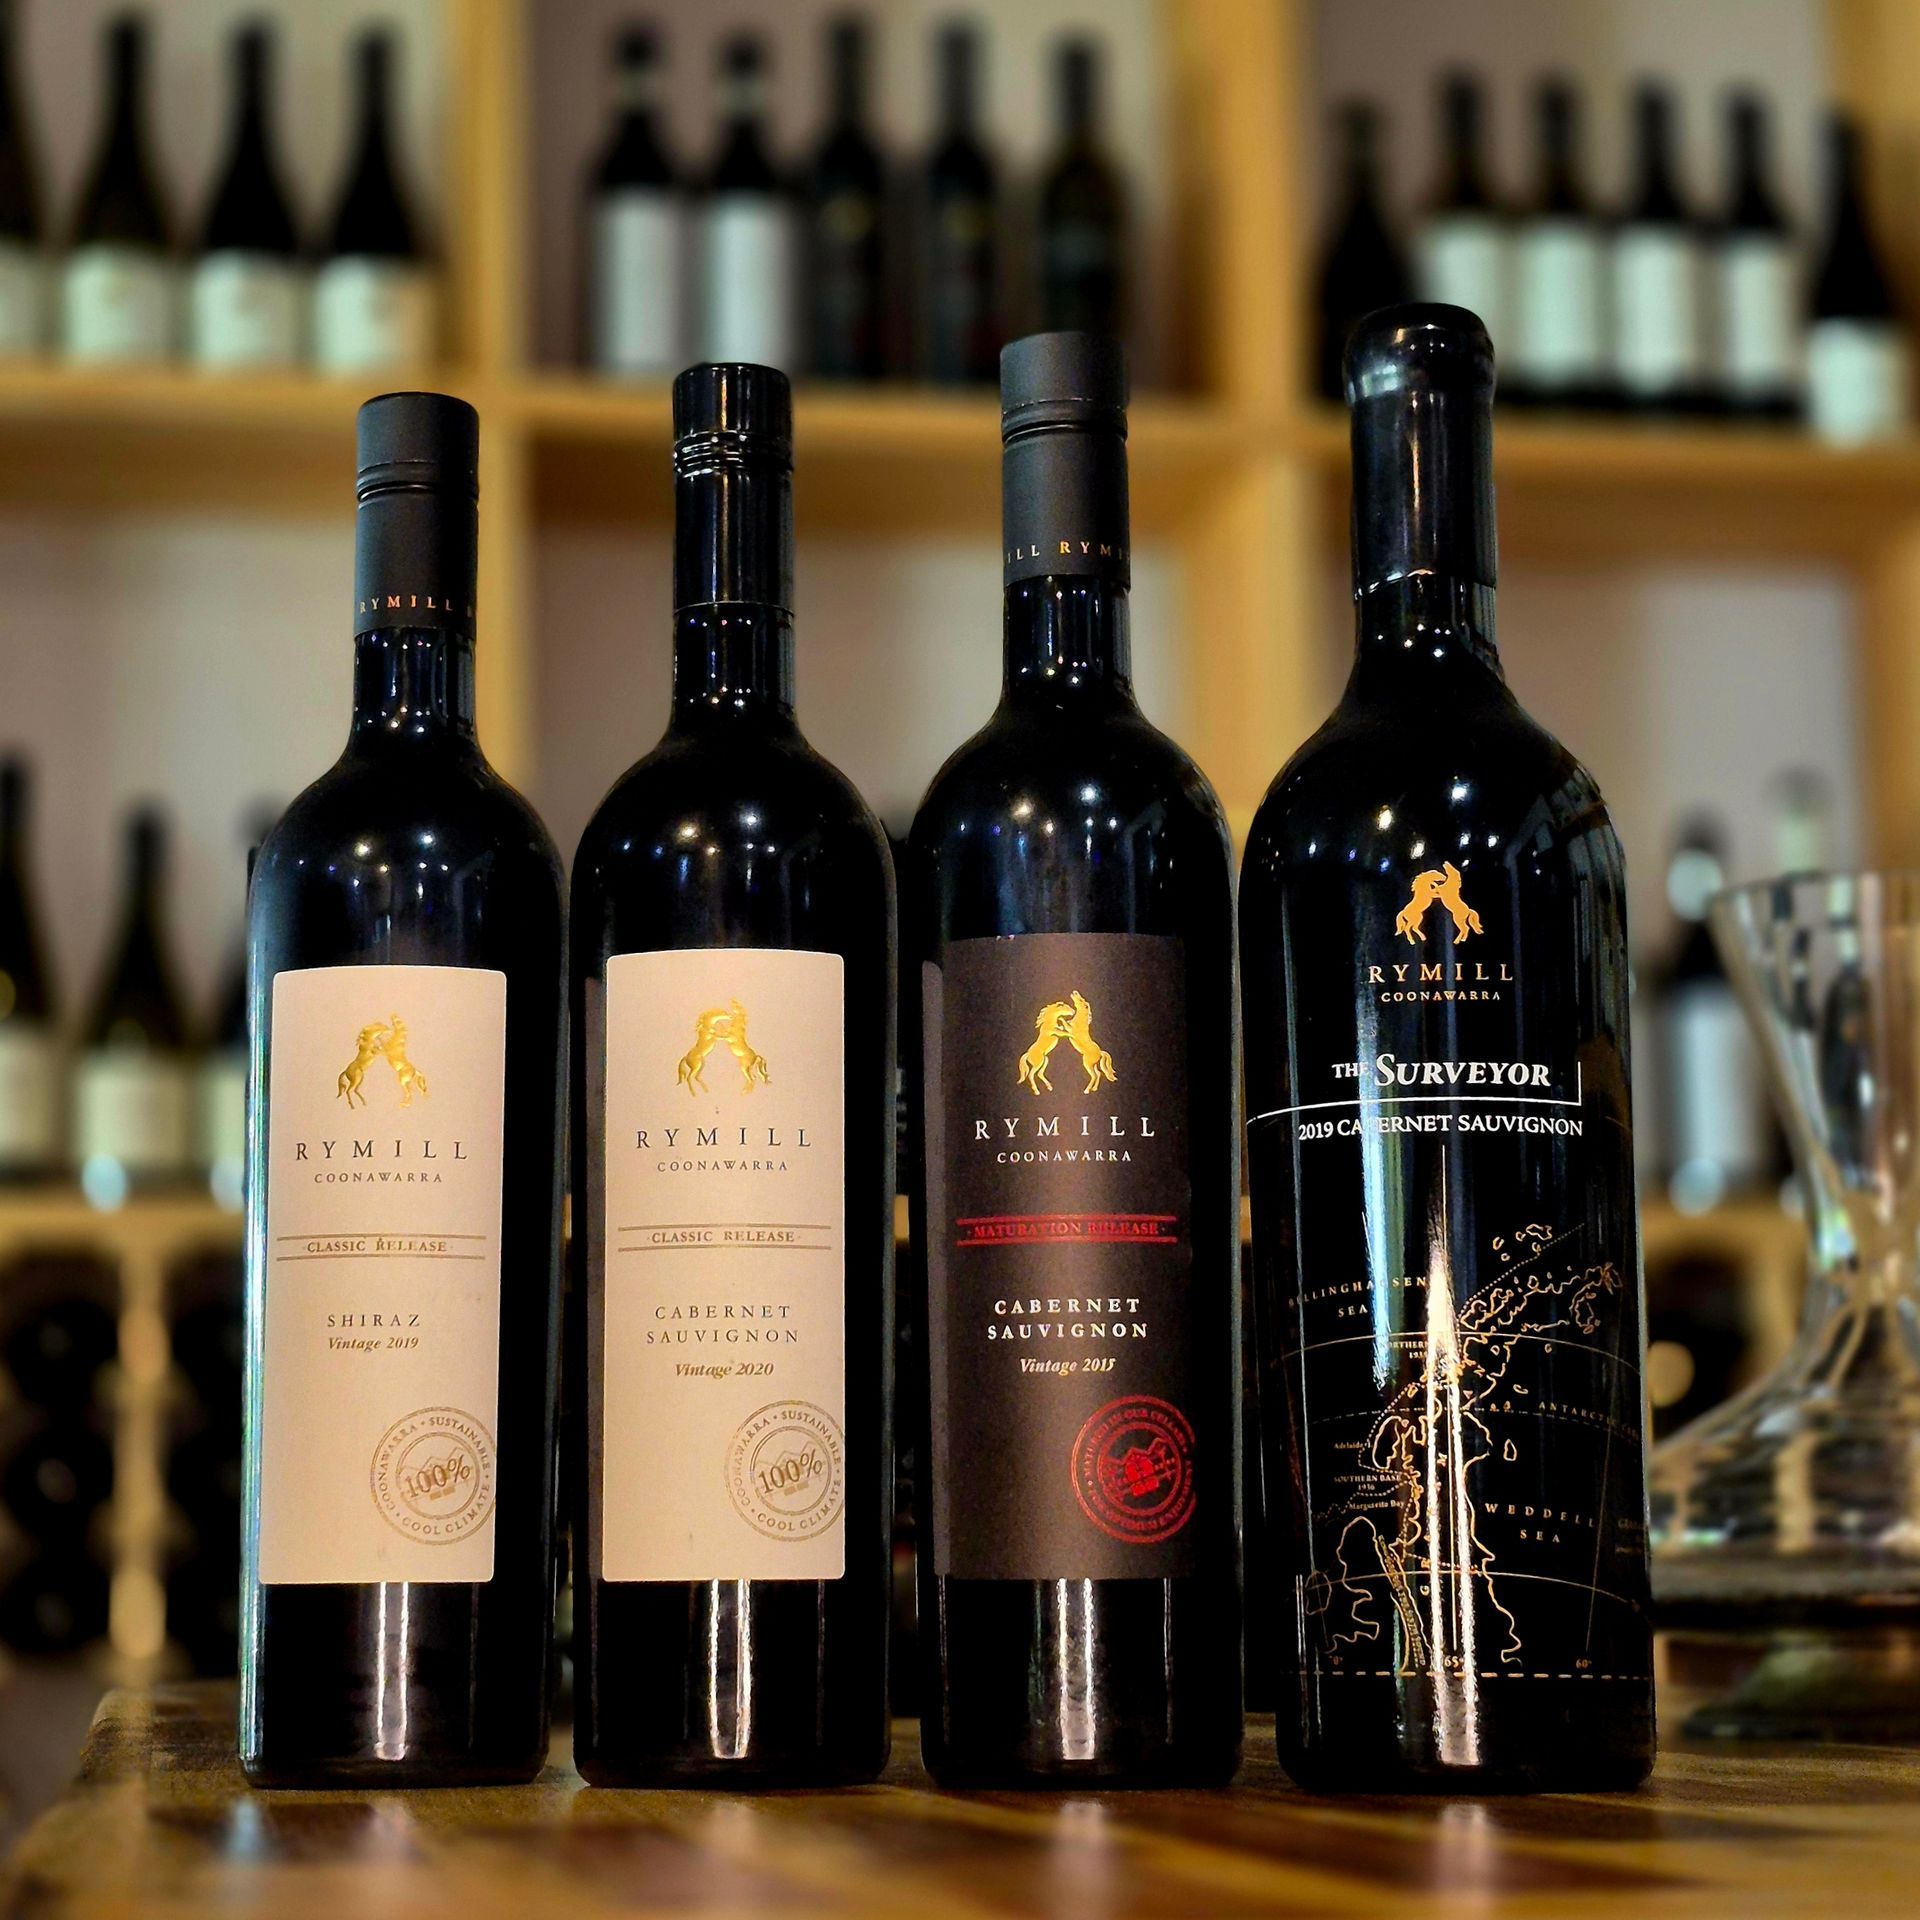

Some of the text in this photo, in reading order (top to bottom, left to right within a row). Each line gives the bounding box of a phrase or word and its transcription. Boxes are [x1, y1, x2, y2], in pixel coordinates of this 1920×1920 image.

[359, 595, 454, 614] RYMILL
[1368, 963, 1514, 984] RYMILL
[1381, 990, 1501, 1002] COONAWARRA
[1331, 1053, 1550, 1087] THE SURVEYOR
[974, 1116, 1155, 1140] RYMILL
[1298, 1114, 1584, 1141] 2019 CAERNET SAUVIGNON
[636, 1127, 811, 1149] RYMILL
[296, 1140, 468, 1161] RYMILL
[997, 1150, 1132, 1163] COONAWARRA
[657, 1160, 788, 1172] COONAWARRA
[314, 1171, 443, 1184] COONAWARRA
[652, 1231, 795, 1243] CLASSIC RELEASE
[974, 1221, 1159, 1238] MATURATION RELEASE
[307, 1240, 447, 1253] CLASSIC RELEASE
[655, 1305, 791, 1320] CABERNET
[994, 1298, 1140, 1315] CABERNET
[1338, 1304, 1369, 1318] SEA
[327, 1314, 421, 1328] SHIRAZ
[646, 1329, 799, 1344] SAUVIGNON
[987, 1323, 1148, 1340] SAUVIGNON
[328, 1337, 419, 1351] Vintage 2019
[675, 1362, 775, 1379] Vintage 2020
[1020, 1358, 1116, 1377] Vintage 2015
[429, 1416, 491, 1471] SUSTAINABLE
[781, 1410, 842, 1466] SUSTAINABLE
[405, 1454, 471, 1498] 100%
[758, 1447, 823, 1494] 100%
[445, 1484, 490, 1534] CLIMATE
[799, 1478, 842, 1530] CLIMATE
[757, 1512, 796, 1532] COOL
[1485, 1502, 1595, 1528] WEDDELL
[402, 1516, 441, 1536] COOL
[1520, 1529, 1560, 1543] SEA
